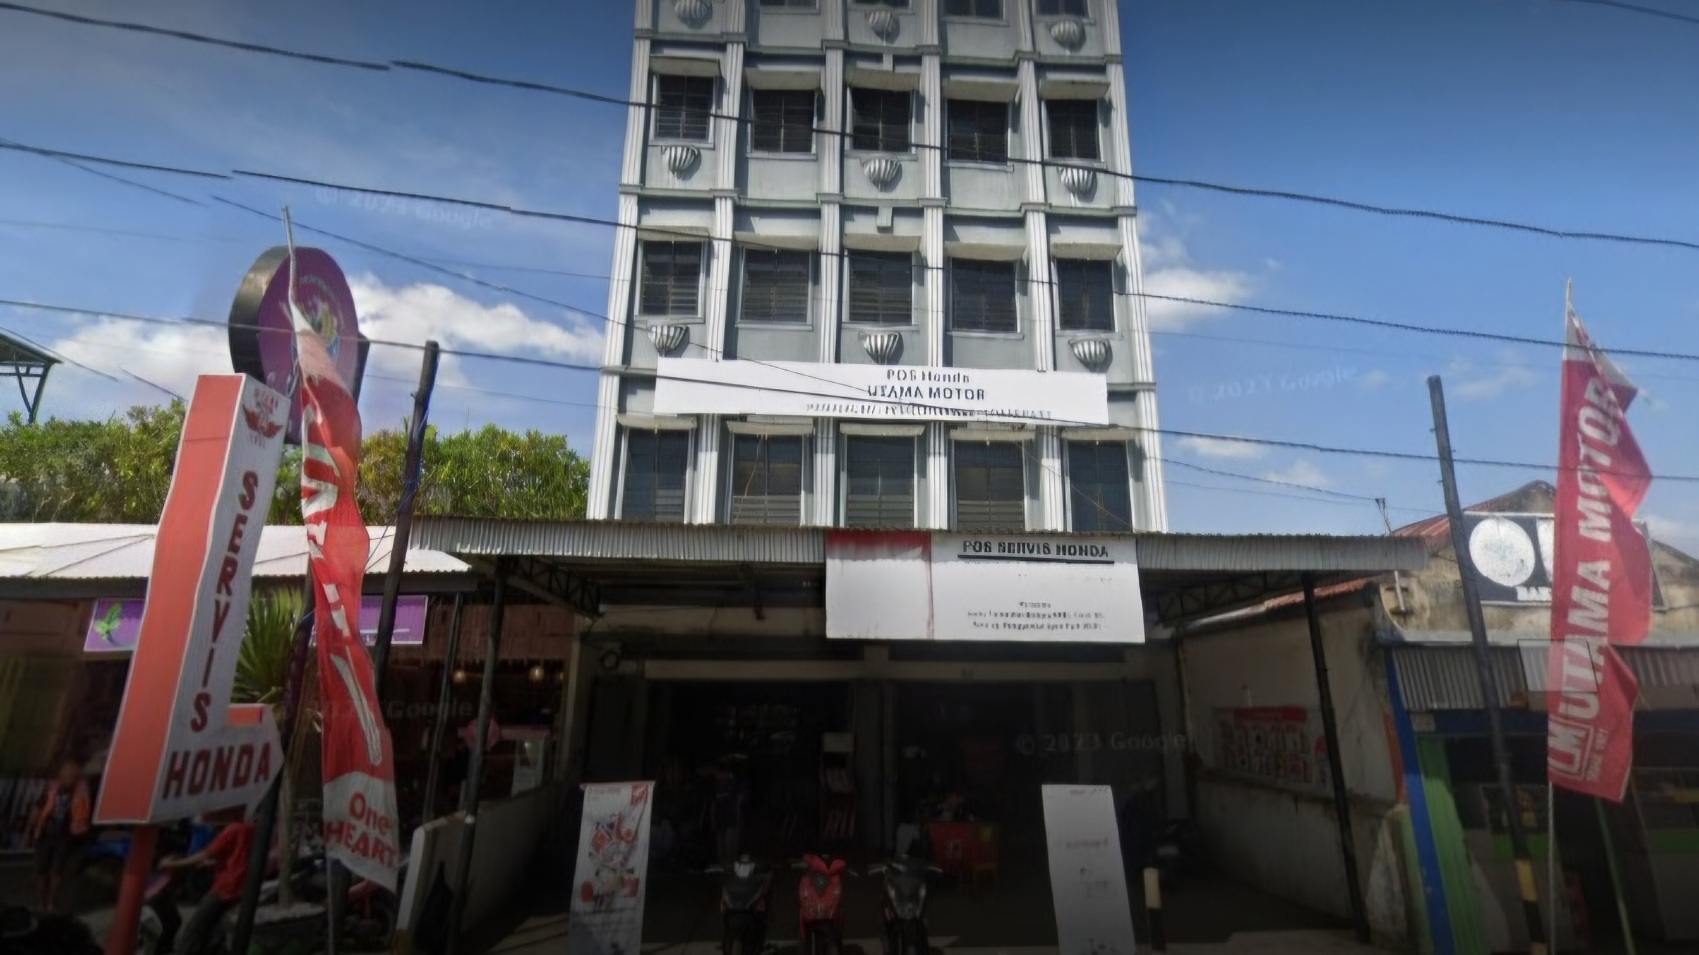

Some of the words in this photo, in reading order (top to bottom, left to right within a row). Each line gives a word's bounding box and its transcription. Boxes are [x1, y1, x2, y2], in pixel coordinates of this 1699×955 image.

[928, 386, 985, 400] MOTOR
[1577, 377, 1624, 543] MOTOR
[190, 470, 259, 734] SERVIS
[1558, 559, 1612, 720] UTAMA
[162, 742, 271, 799] HONDA
[349, 790, 389, 836] One
